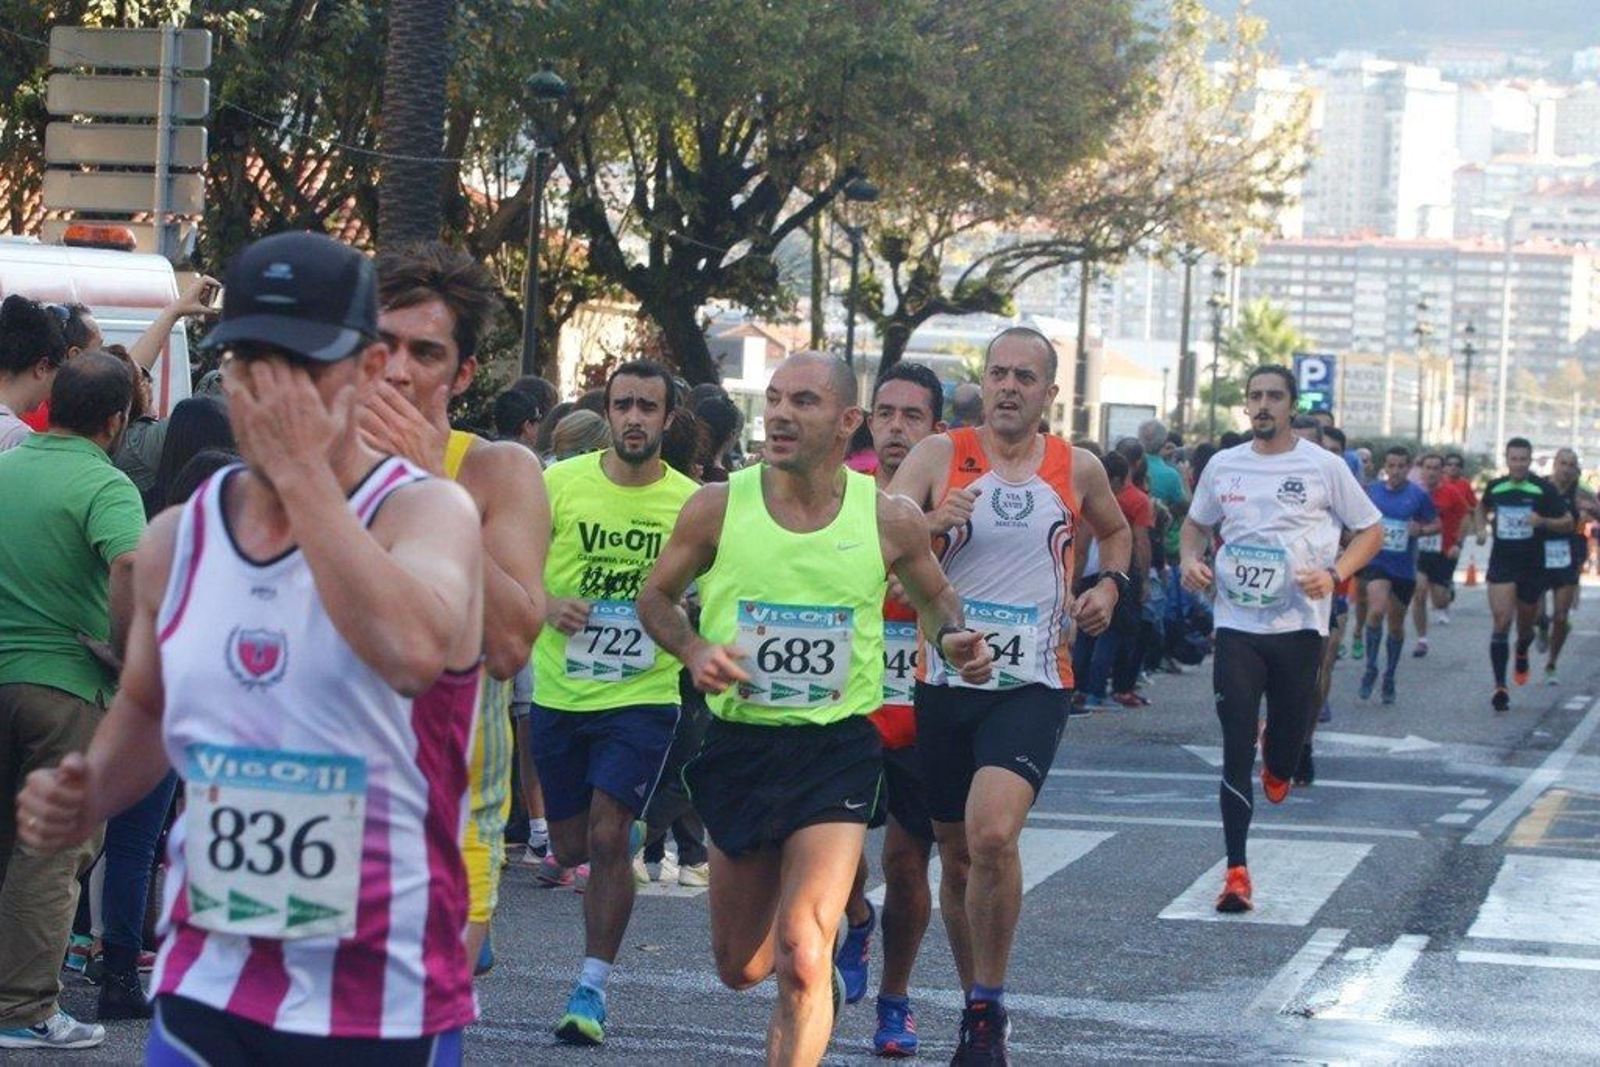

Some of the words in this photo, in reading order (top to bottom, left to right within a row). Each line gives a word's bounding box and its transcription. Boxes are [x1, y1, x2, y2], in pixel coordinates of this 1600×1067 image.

[1299, 358, 1326, 391] P
[1235, 564, 1276, 589] 927
[584, 625, 642, 657] 722
[757, 637, 835, 675] 683
[208, 807, 336, 880] 836
